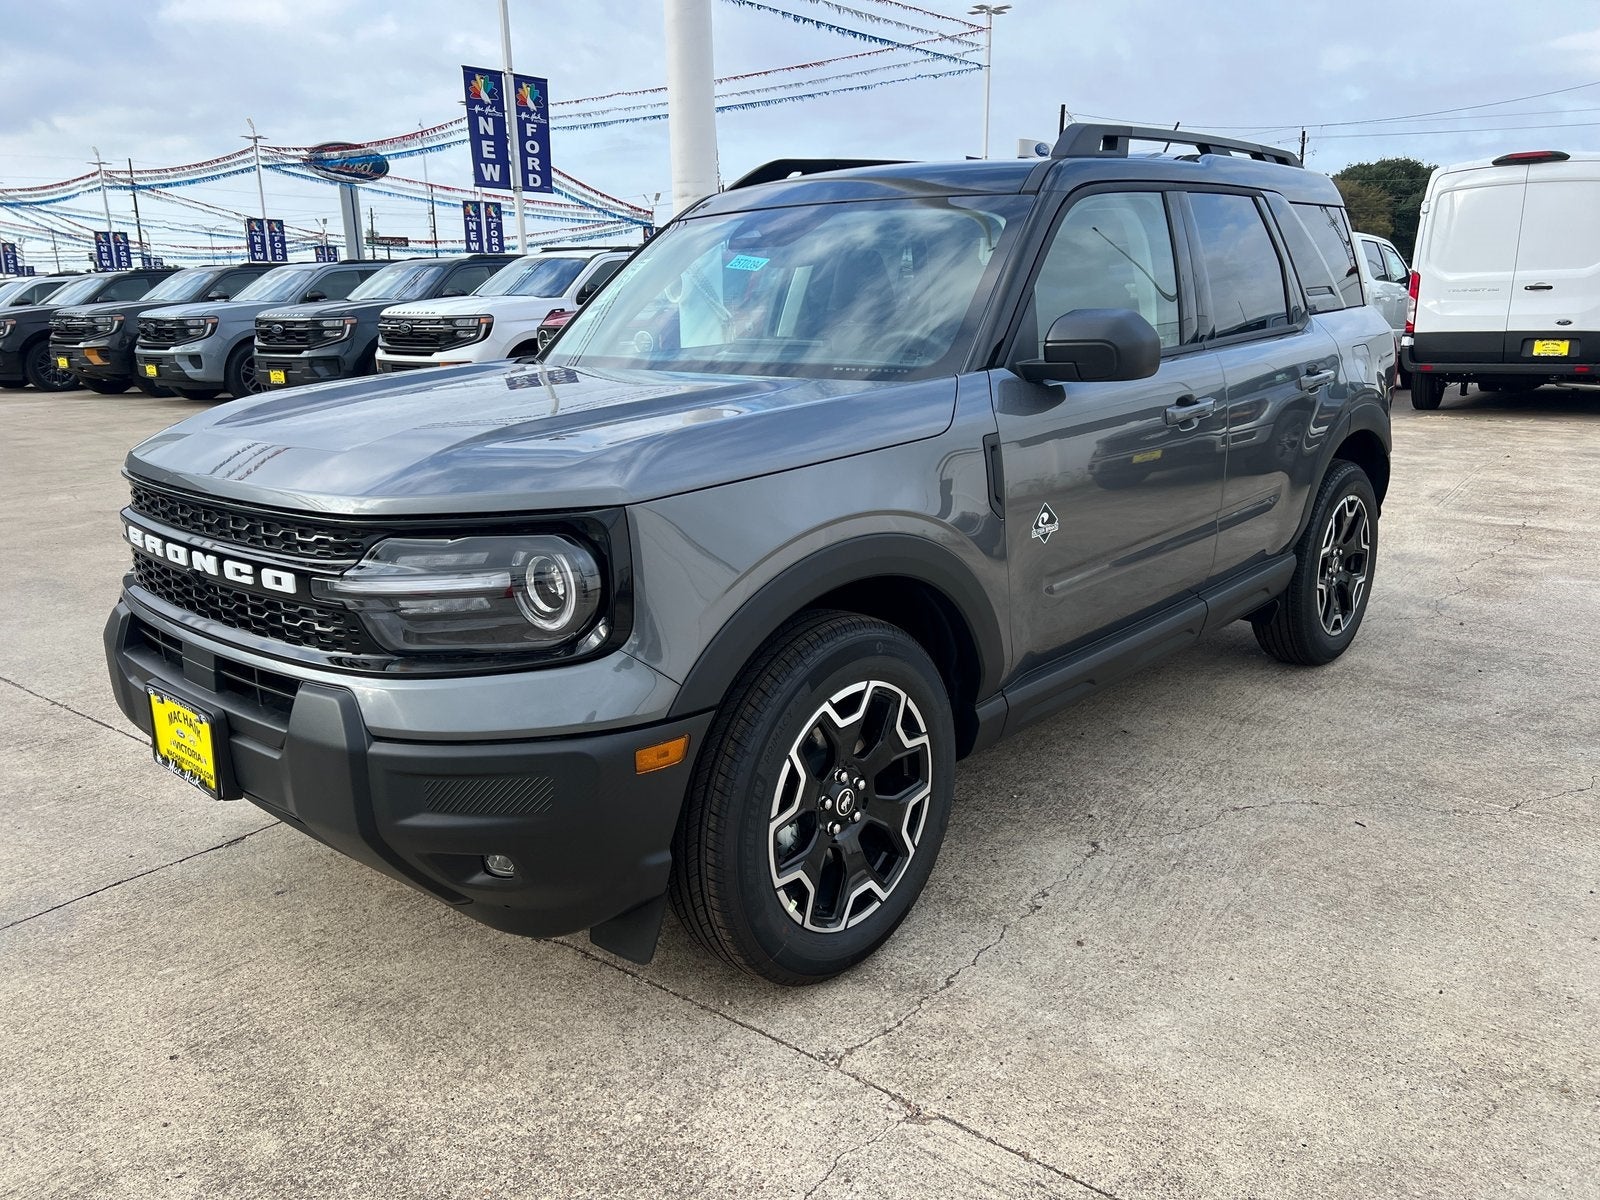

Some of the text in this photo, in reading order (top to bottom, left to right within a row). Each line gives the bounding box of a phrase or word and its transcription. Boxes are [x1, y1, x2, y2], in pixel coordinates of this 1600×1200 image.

[479, 116, 501, 182] NEW
[525, 123, 542, 188] FORD
[253, 235, 264, 260] NEW
[273, 235, 283, 261] FORD
[468, 221, 479, 251] NEW
[490, 222, 499, 252] FORD
[100, 244, 110, 267] NEW
[119, 245, 128, 267] FORD
[128, 525, 297, 594] BRONCO
[167, 710, 202, 743] MAC HAIK
[764, 709, 793, 764] PRIMACY
